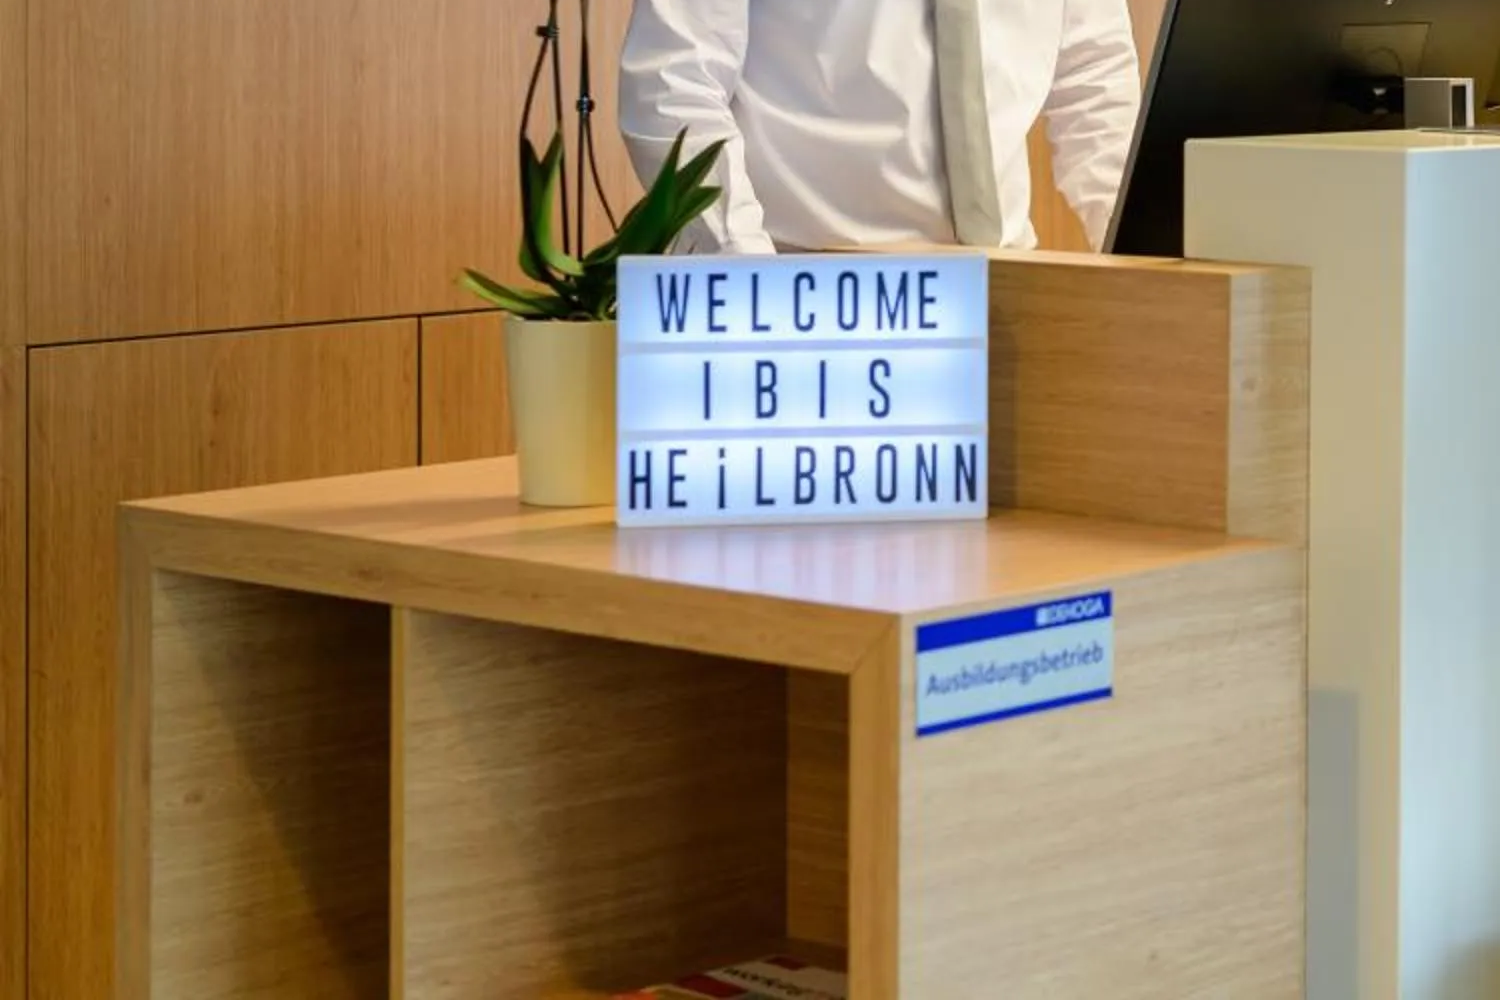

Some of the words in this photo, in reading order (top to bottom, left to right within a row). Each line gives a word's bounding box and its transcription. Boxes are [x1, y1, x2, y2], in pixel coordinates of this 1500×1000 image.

[656, 271, 939, 332] WELCOME
[703, 358, 891, 420] IBIS
[926, 640, 1104, 696] Ausbildungsbetrieb
